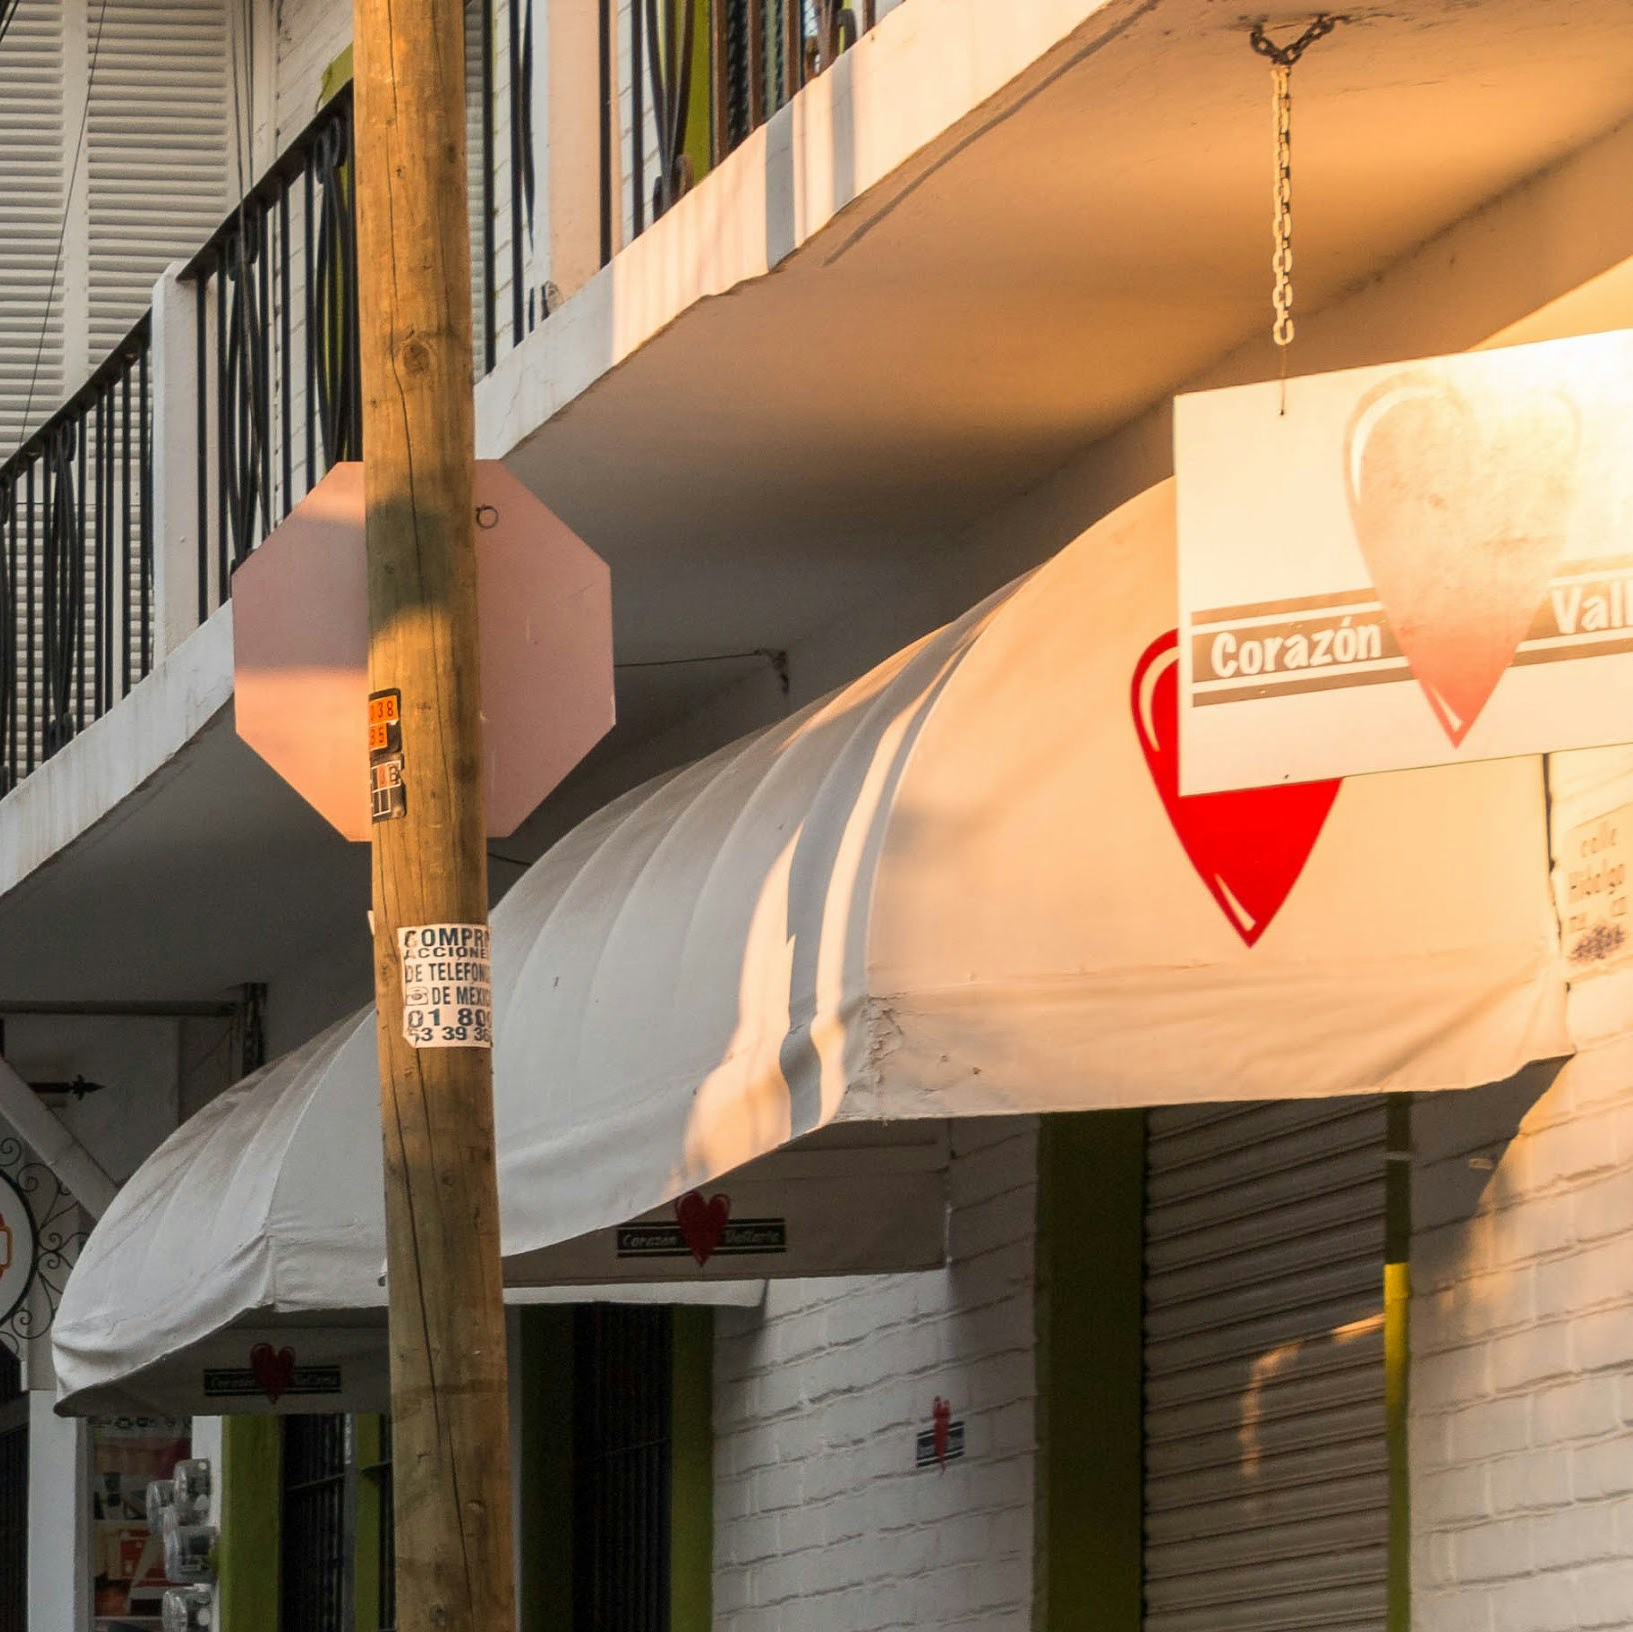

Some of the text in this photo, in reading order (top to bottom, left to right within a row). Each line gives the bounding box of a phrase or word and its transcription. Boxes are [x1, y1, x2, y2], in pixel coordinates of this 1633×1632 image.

[1210, 616, 1383, 679] Corazón
[405, 962, 490, 983] DE TELEFO
[432, 986, 490, 1006] DE MEX
[407, 1008, 441, 1029] 01
[442, 1026, 467, 1041] 39
